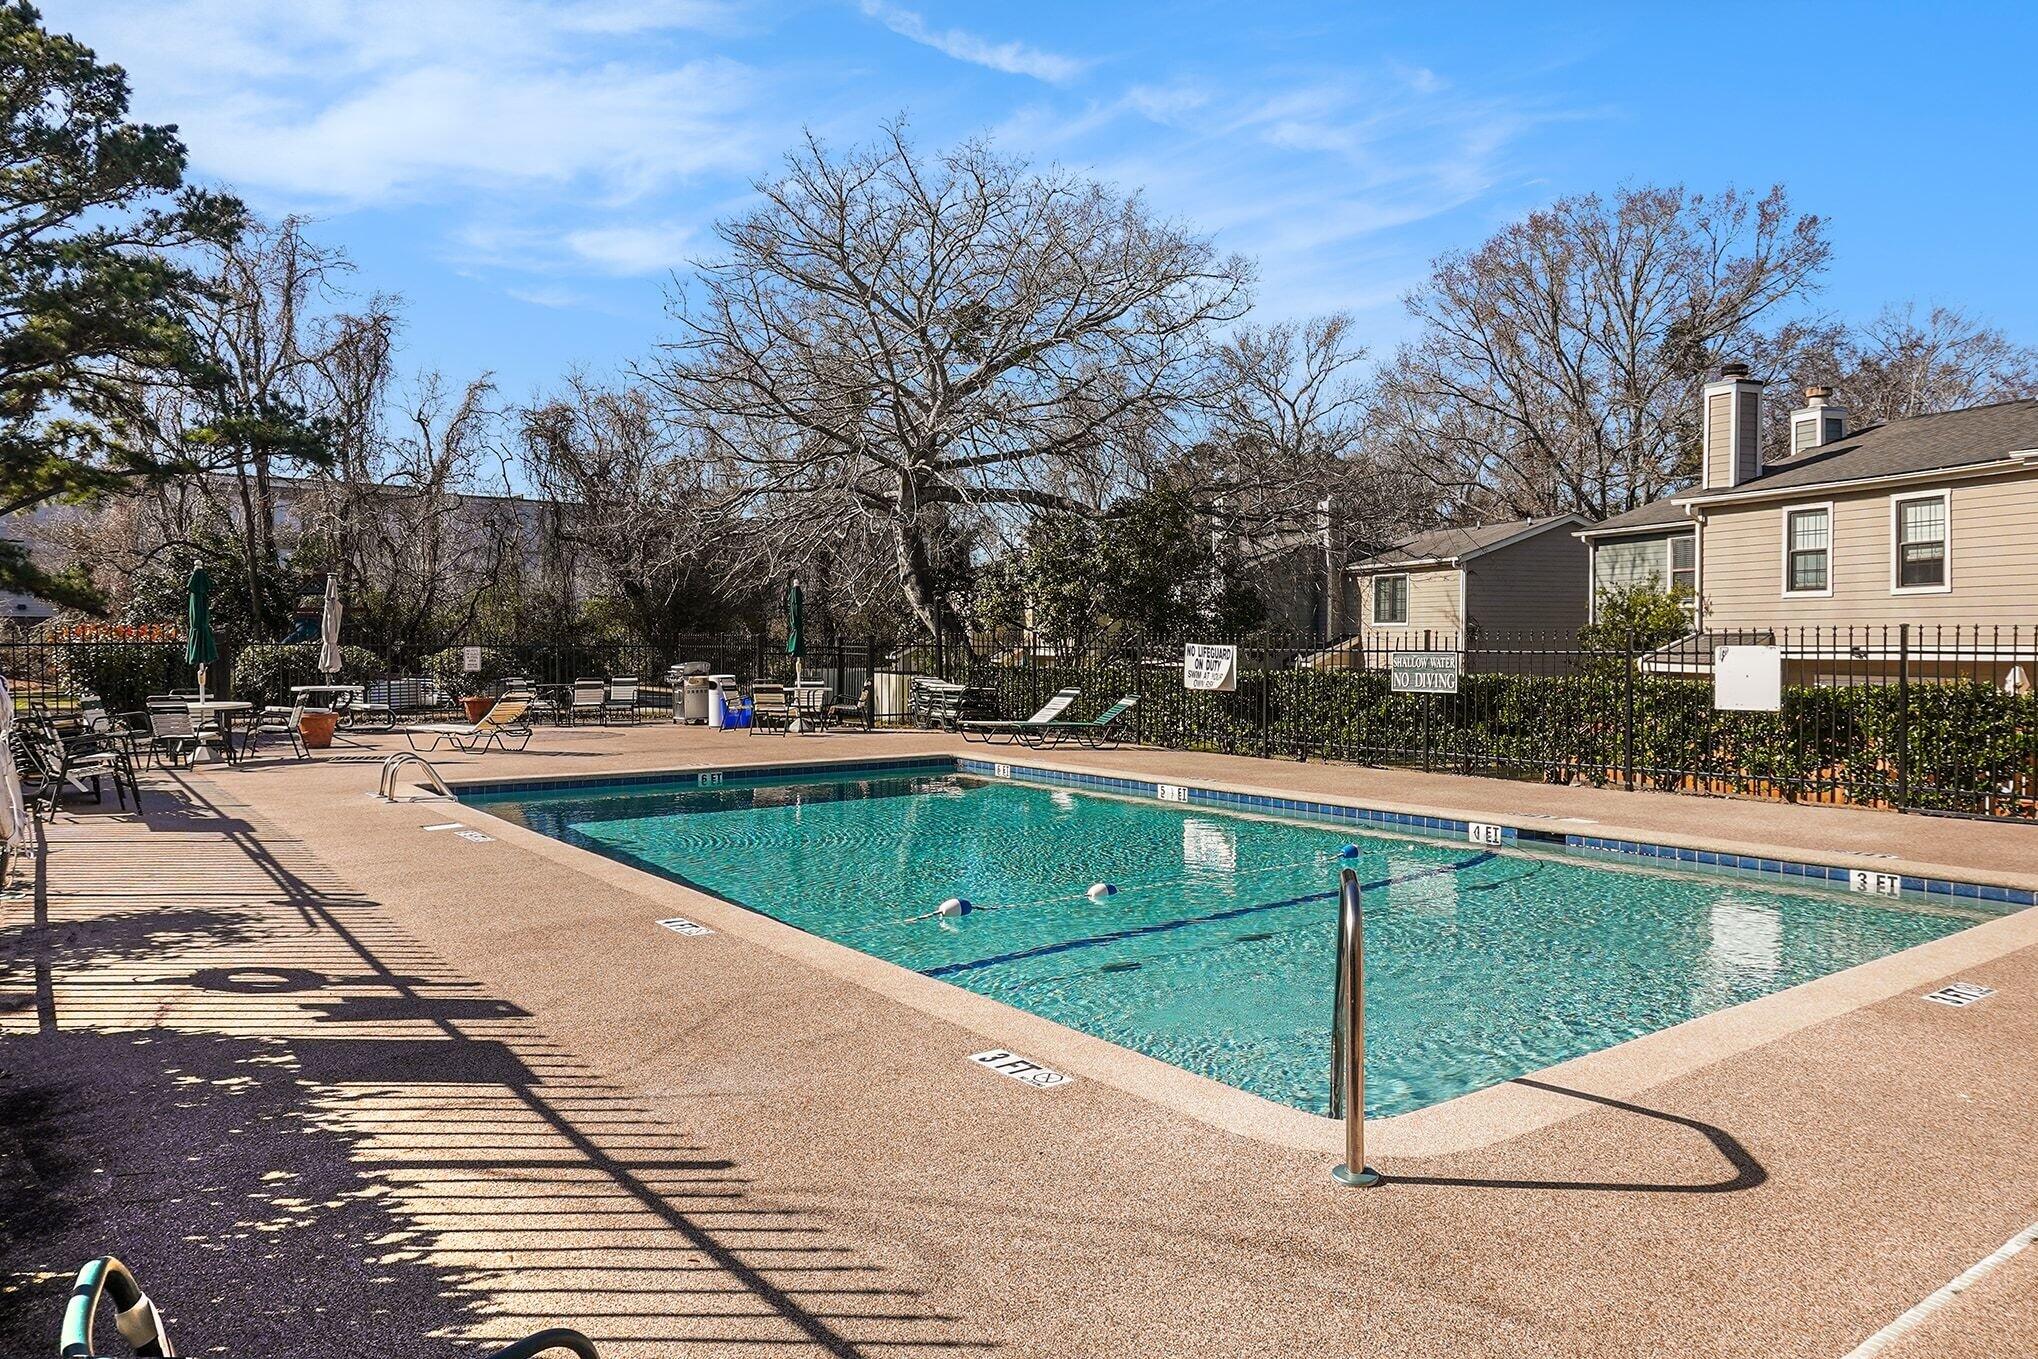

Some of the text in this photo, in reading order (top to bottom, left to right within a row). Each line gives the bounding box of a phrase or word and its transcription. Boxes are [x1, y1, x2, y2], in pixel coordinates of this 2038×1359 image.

[1187, 645, 1231, 660] NO LIFEGUARD
[1194, 658, 1222, 671] ON DUTY
[1393, 657, 1456, 669] SHALLOW WATER
[1203, 671, 1210, 680] AT
[1393, 672, 1455, 689] NO DIVING
[1938, 987, 1981, 1002] FT
[978, 1053, 1043, 1075] 3 FT
